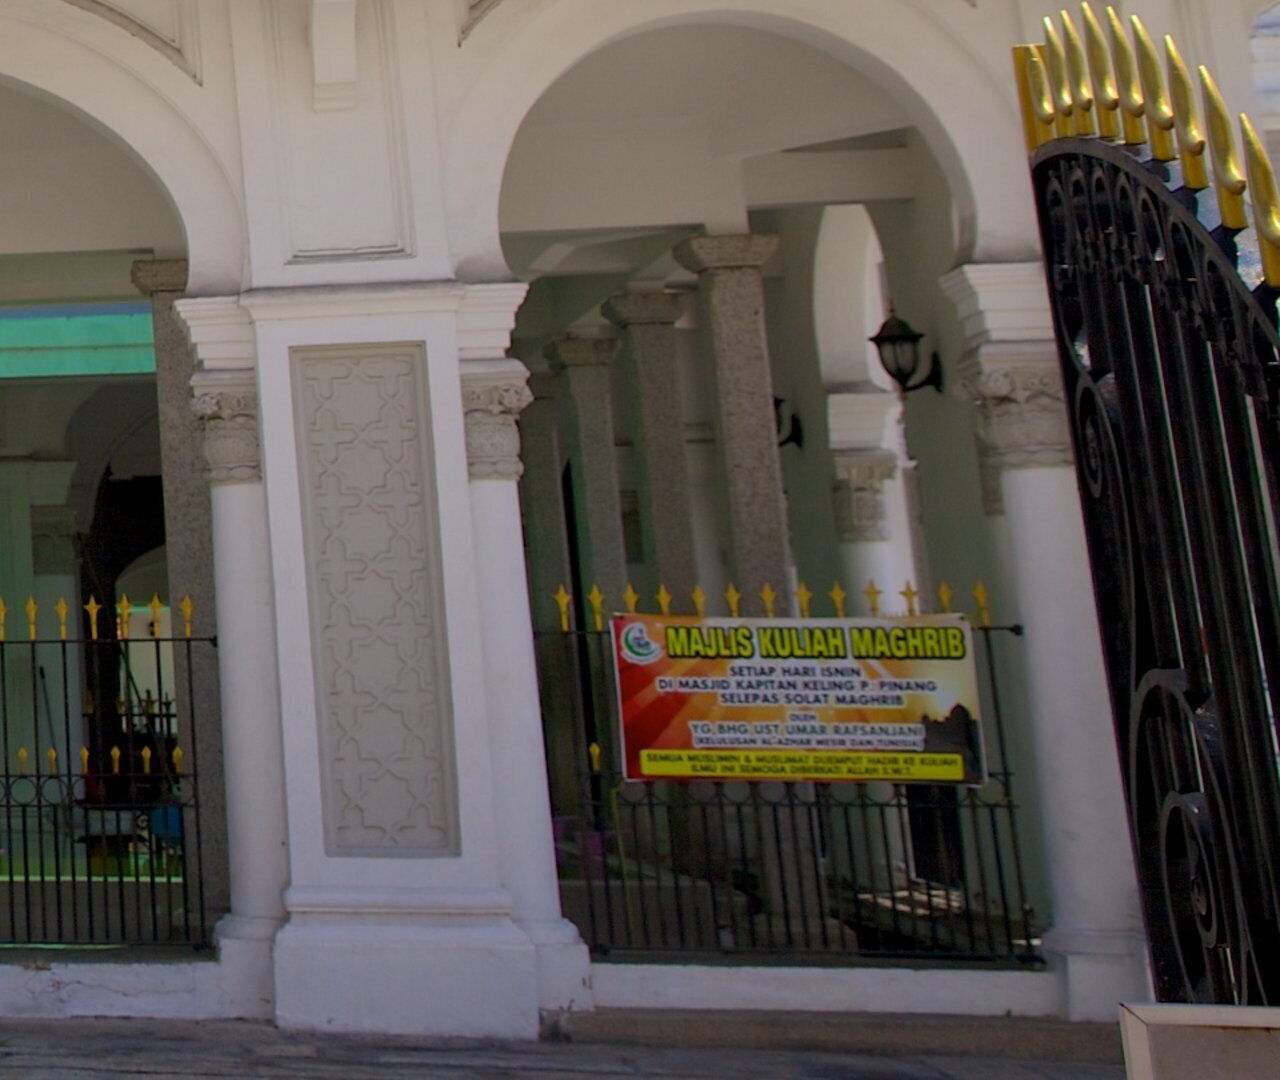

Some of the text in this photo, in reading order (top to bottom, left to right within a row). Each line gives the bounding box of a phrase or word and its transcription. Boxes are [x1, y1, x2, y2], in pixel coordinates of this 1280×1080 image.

[665, 626, 966, 659] MAJLIS KULIAH MAGHRIB
[729, 666, 861, 677] SETIAP HARI ISNIN
[658, 679, 673, 689] DI
[679, 679, 730, 690] MASJID
[736, 680, 797, 690] KAPITAN
[803, 680, 854, 691] KELING
[879, 681, 937, 691] PINANG
[721, 693, 904, 705] SELEPAS SOLAT MAGHRIB
[785, 724, 827, 735] UMAR
